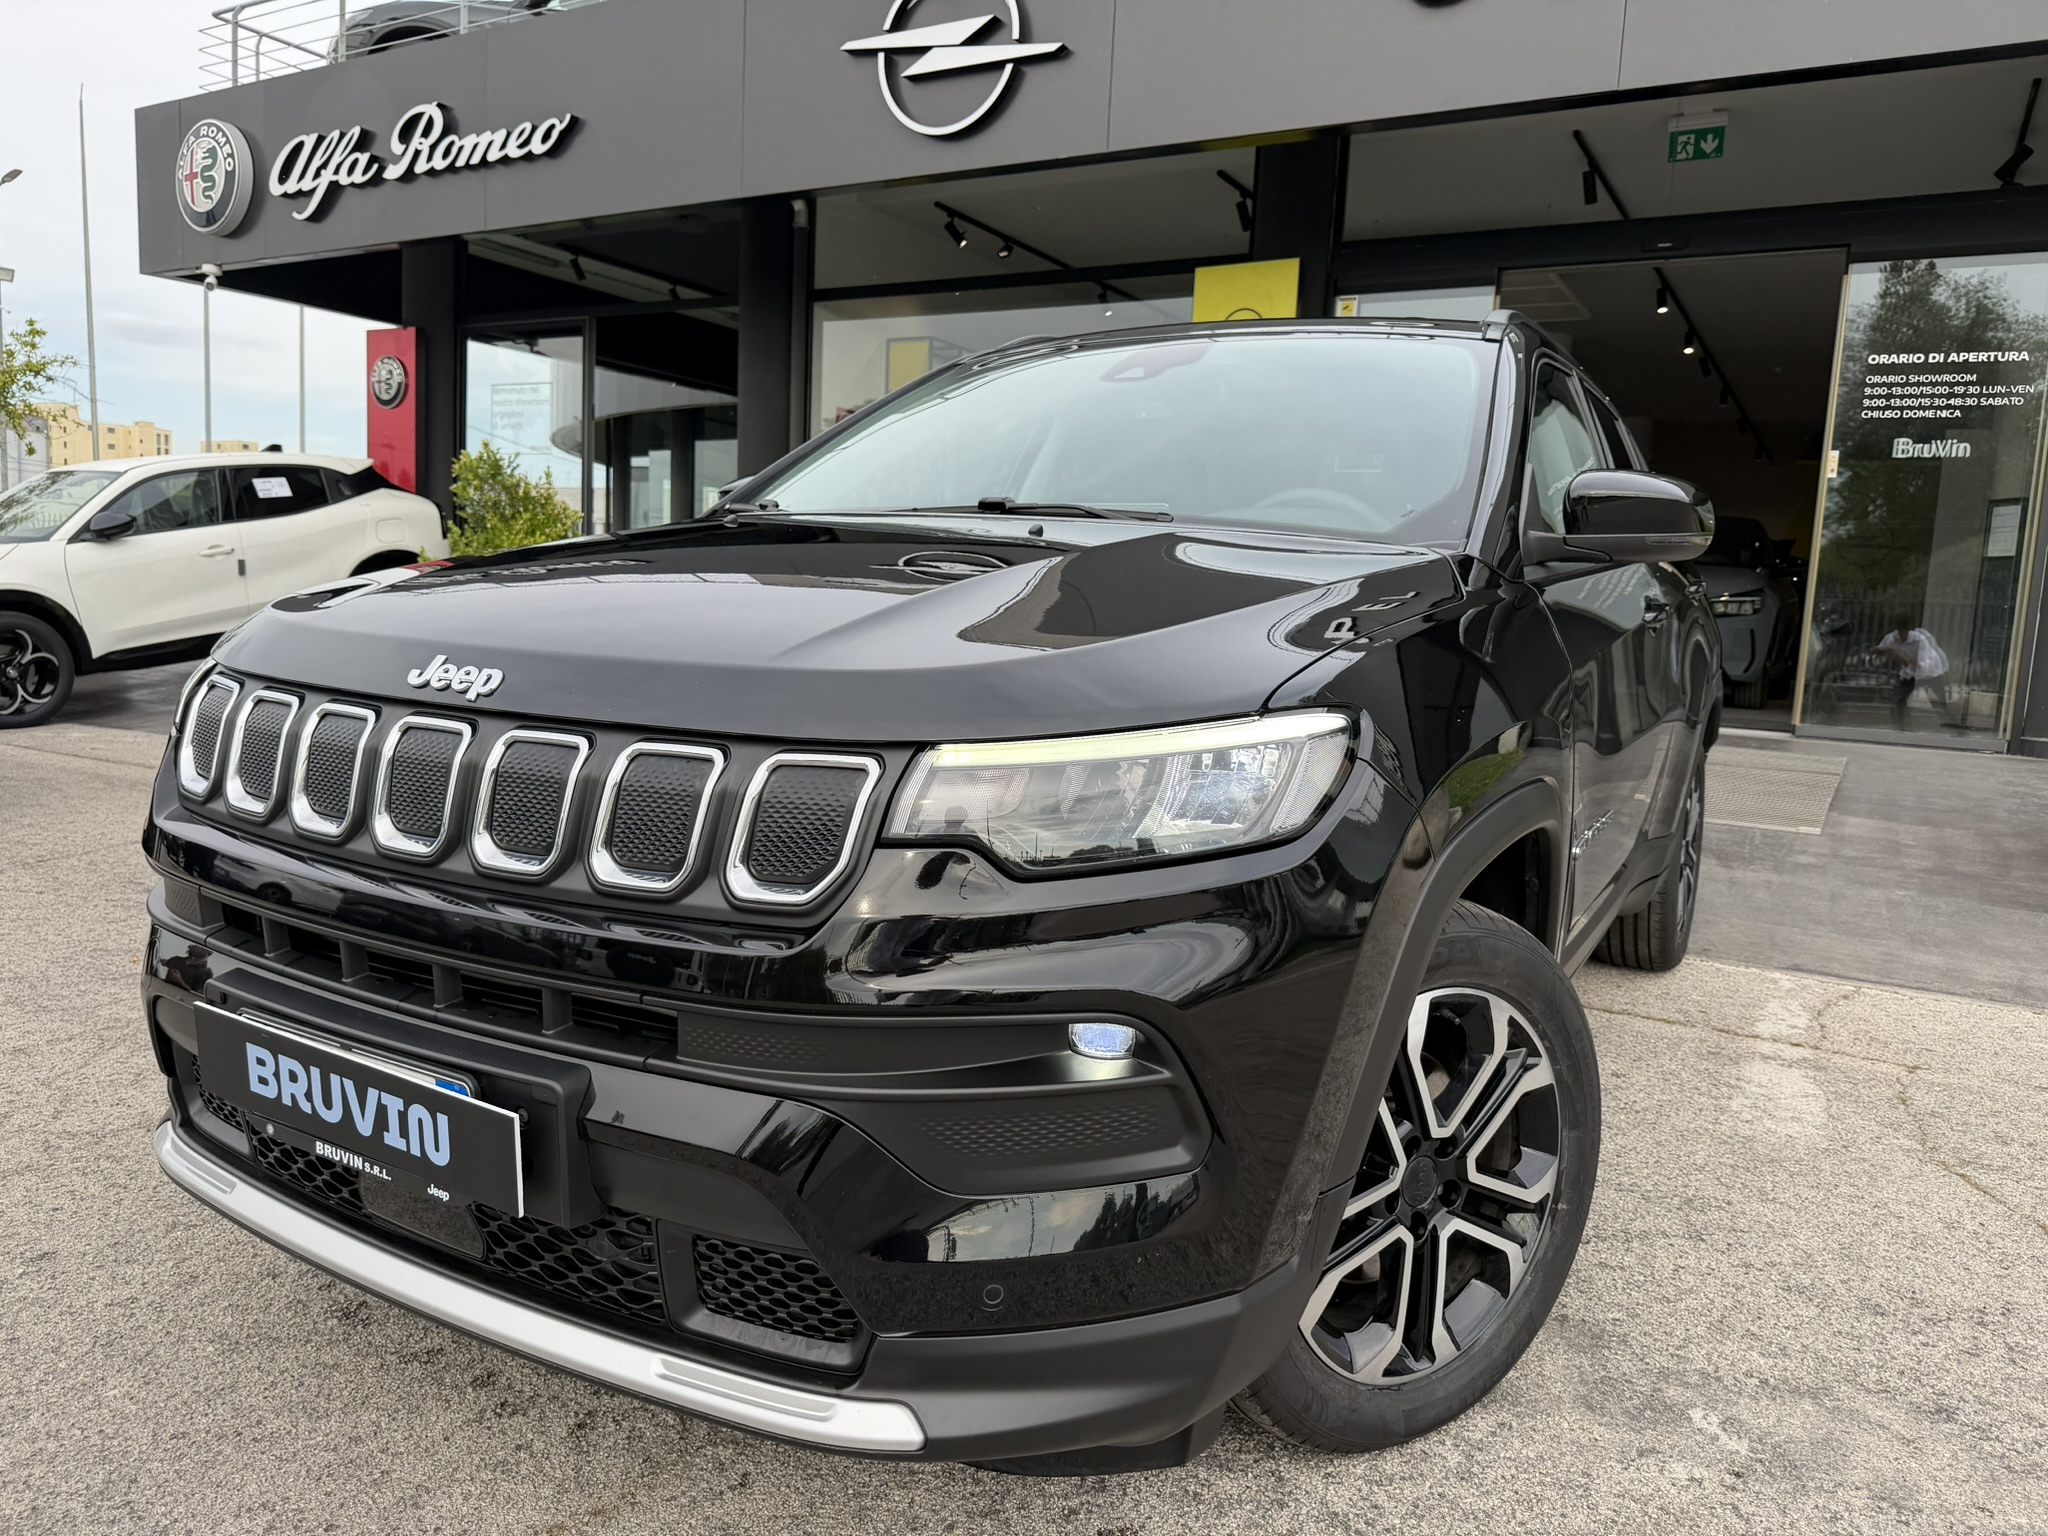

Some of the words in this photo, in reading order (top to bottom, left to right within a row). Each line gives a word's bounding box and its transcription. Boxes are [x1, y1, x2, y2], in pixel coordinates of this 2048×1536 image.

[199, 125, 235, 172] ROMEO
[268, 125, 379, 221] Alfa
[382, 101, 572, 180] Romeo
[1867, 353, 1925, 365] ORARIO
[1927, 352, 1945, 363] DI
[1947, 351, 2030, 363] APERTURA
[1865, 374, 1907, 384] ORARIO
[1908, 373, 1977, 383] SHOWROOM
[1982, 384, 2035, 394] LUN-VEN
[1979, 396, 2024, 406] SABATO
[1861, 409, 1901, 419] CHIUSO
[1902, 409, 1962, 418] DOMENICA
[407, 654, 504, 702] Jeep
[245, 1041, 451, 1167] BRUVIN
[315, 1140, 363, 1170] BRUVIN
[364, 1162, 392, 1181] S.R.L.
[427, 1183, 450, 1202] Jeep
